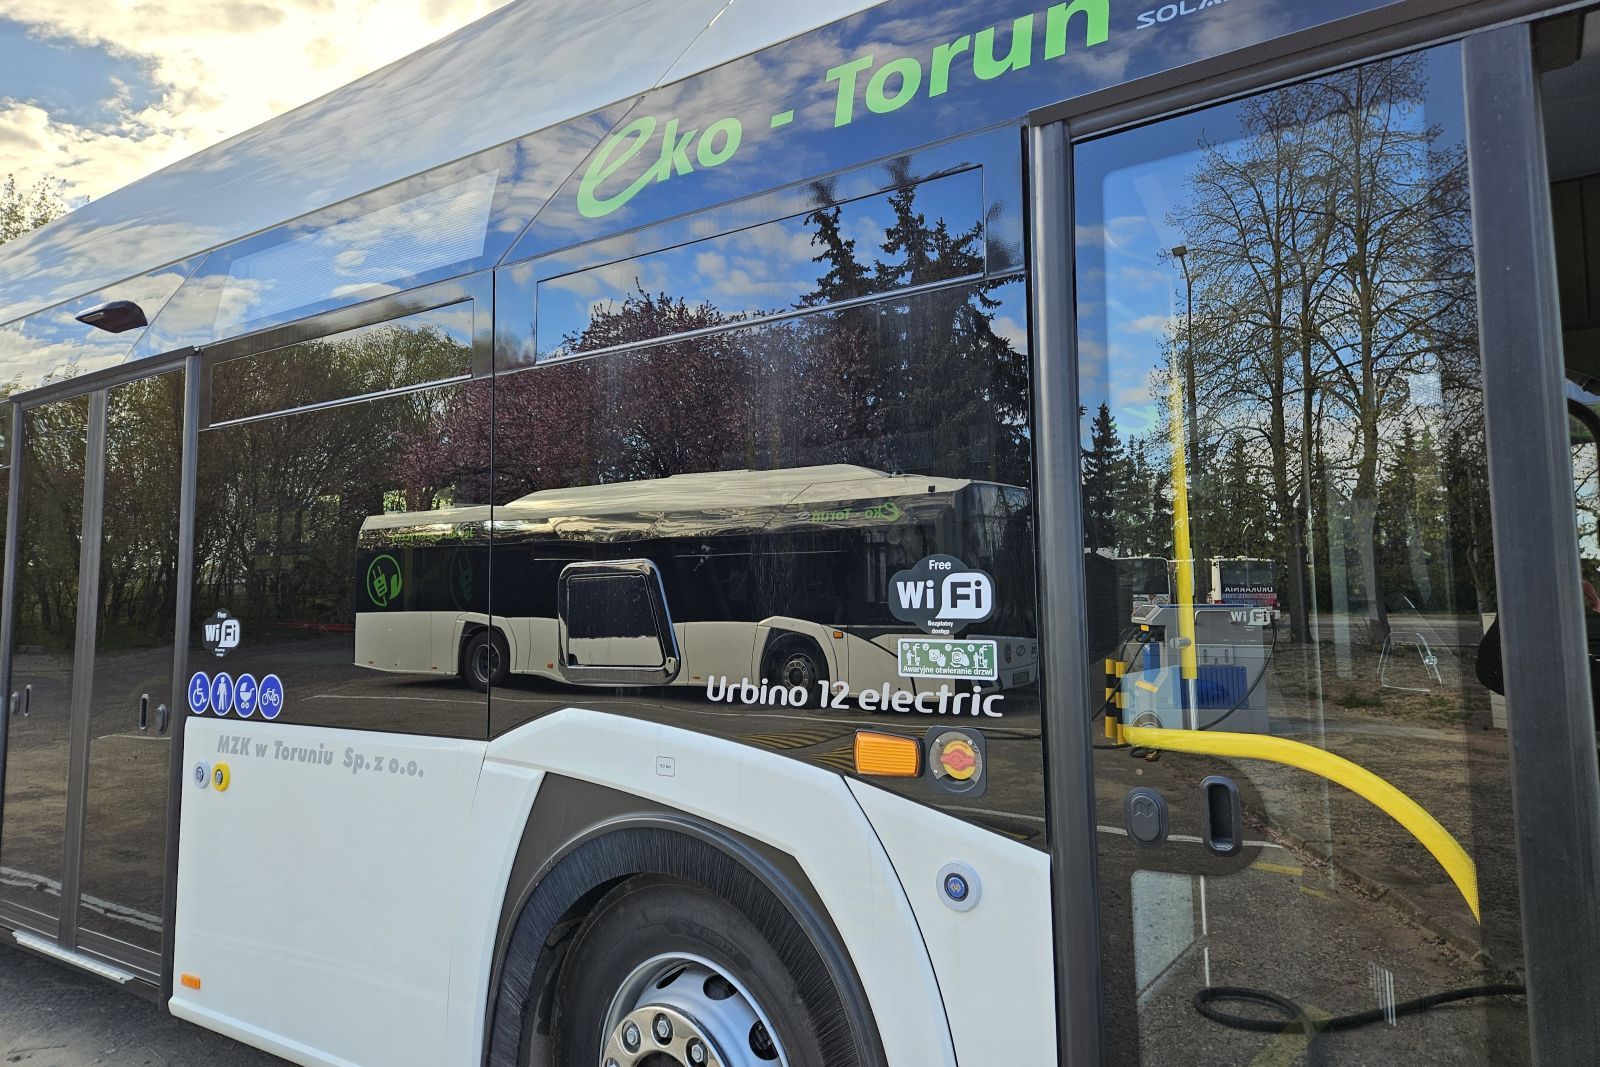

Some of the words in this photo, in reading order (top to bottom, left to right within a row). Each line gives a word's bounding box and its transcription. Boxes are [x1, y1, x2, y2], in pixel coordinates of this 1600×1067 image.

[928, 560, 952, 570] Free
[903, 665, 934, 676] Awaryjne
[935, 666, 973, 675] otwieranie
[973, 668, 993, 676] drzwi
[706, 675, 809, 708] Urbino
[817, 680, 850, 709] 12
[858, 682, 1005, 718] electric
[216, 735, 252, 756] MZK
[255, 743, 268, 758] w
[274, 740, 334, 766] Toruniu
